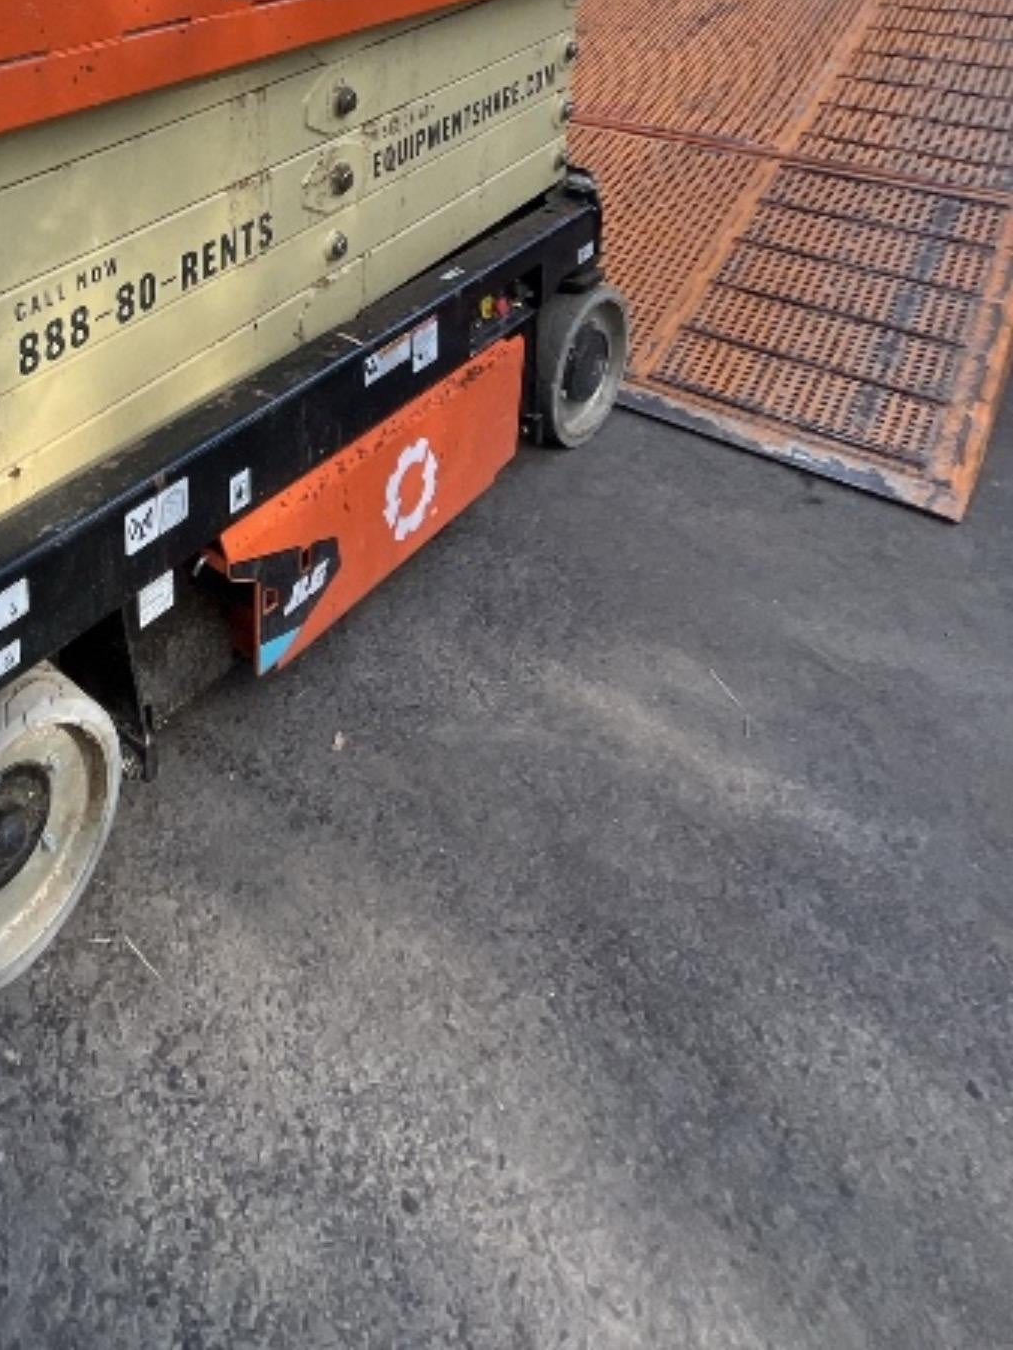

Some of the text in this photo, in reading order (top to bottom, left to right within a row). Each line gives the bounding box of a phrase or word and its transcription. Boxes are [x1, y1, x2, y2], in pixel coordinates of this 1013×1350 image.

[14, 257, 119, 322] CALL NOW
[19, 212, 274, 376] 888-80-RENTS
